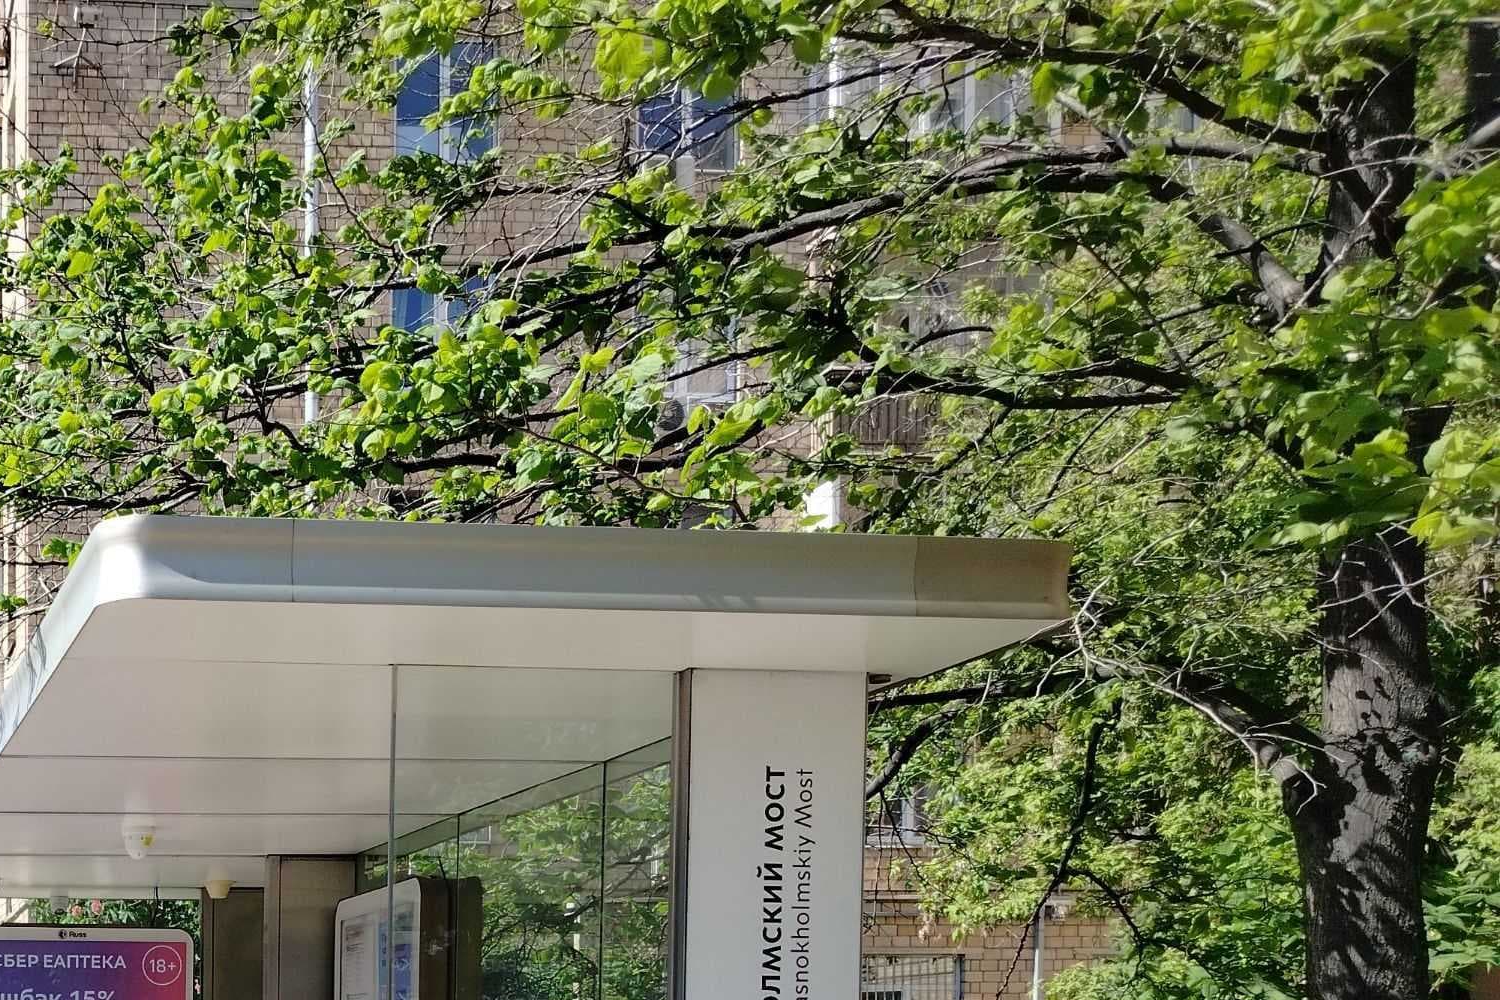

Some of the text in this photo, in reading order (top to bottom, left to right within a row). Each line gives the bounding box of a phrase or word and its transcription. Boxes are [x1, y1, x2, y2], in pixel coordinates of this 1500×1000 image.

[764, 765, 786, 852] мост
[794, 768, 813, 829] Most
[43, 954, 127, 969] ЕАПТЕКА
[149, 958, 177, 974] 18+
